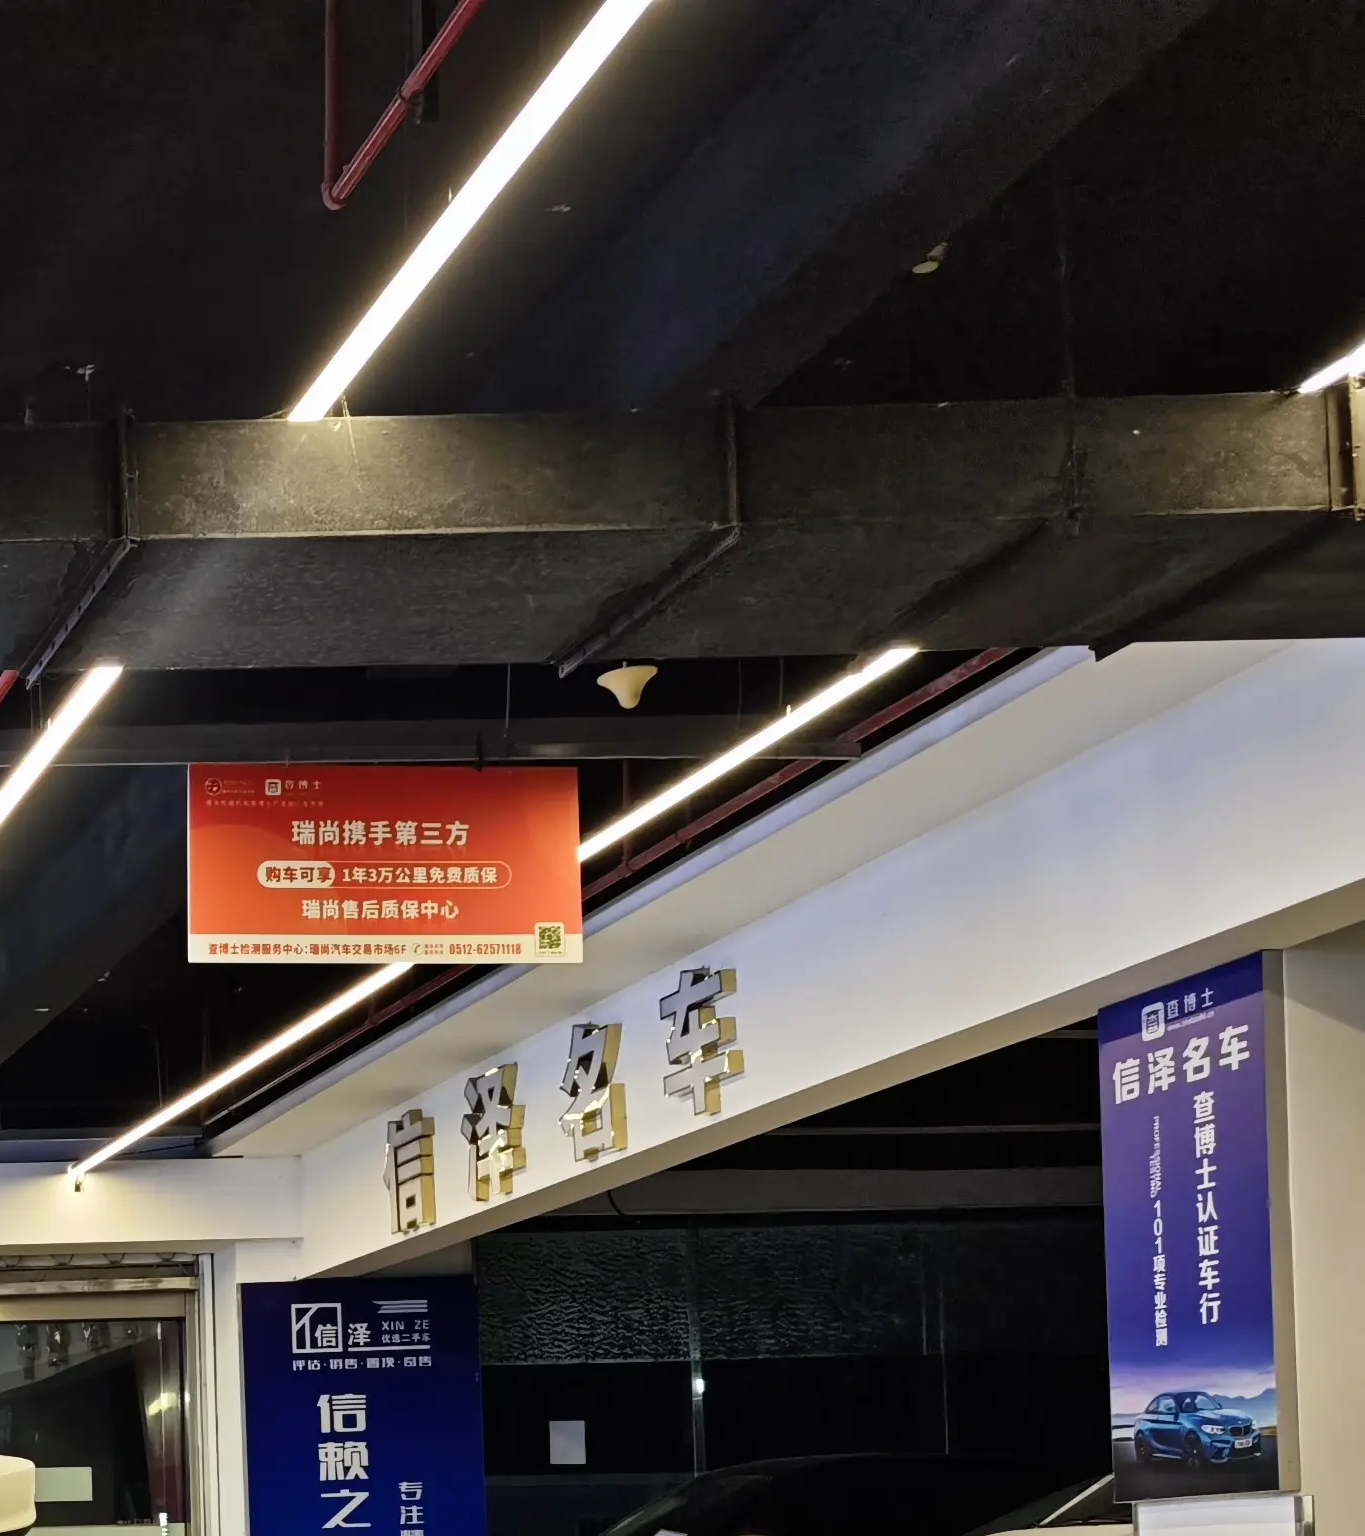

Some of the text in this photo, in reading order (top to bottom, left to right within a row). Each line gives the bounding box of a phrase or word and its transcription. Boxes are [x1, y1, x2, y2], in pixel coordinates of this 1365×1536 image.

[291, 820, 470, 846] 瑞尚携手第三方
[265, 865, 498, 884] 购车可享 1年3万公里免费质保
[301, 899, 460, 920] 瑞尚售后质保中心
[1167, 987, 1215, 1020] 查博士
[1112, 1024, 1251, 1105] 信泽名车
[383, 966, 744, 1234] 信泽名车
[1192, 1091, 1222, 1325] 查博士认证车行
[1152, 1199, 1168, 1347] 101项专业检测
[313, 1322, 372, 1347] 信泽
[381, 1319, 430, 1331] XIN ZE
